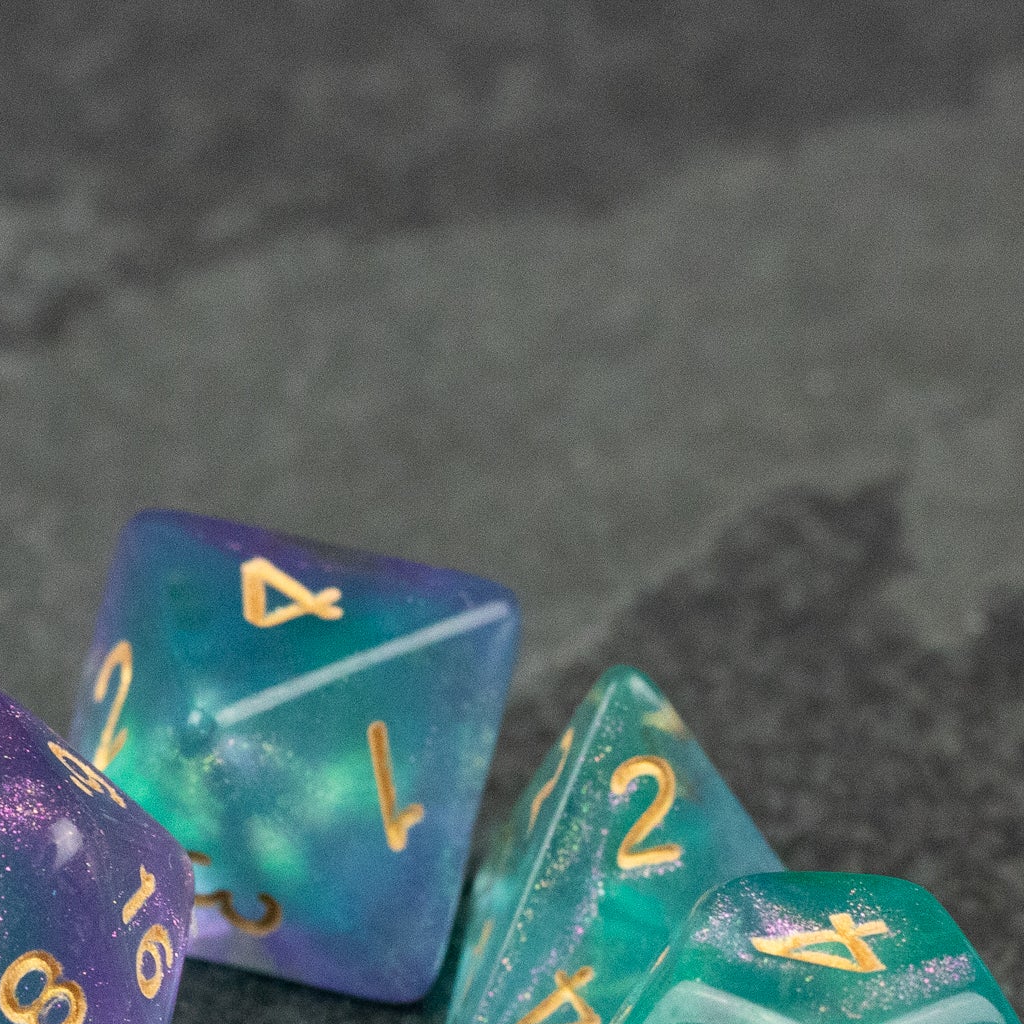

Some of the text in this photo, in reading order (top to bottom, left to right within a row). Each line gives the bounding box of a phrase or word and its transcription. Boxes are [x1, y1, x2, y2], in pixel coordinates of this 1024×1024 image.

[240, 557, 344, 628] 4
[94, 640, 134, 772] 2
[368, 720, 425, 853] 1
[611, 755, 683, 870] 2
[122, 864, 173, 999] 16
[751, 913, 890, 973] 4
